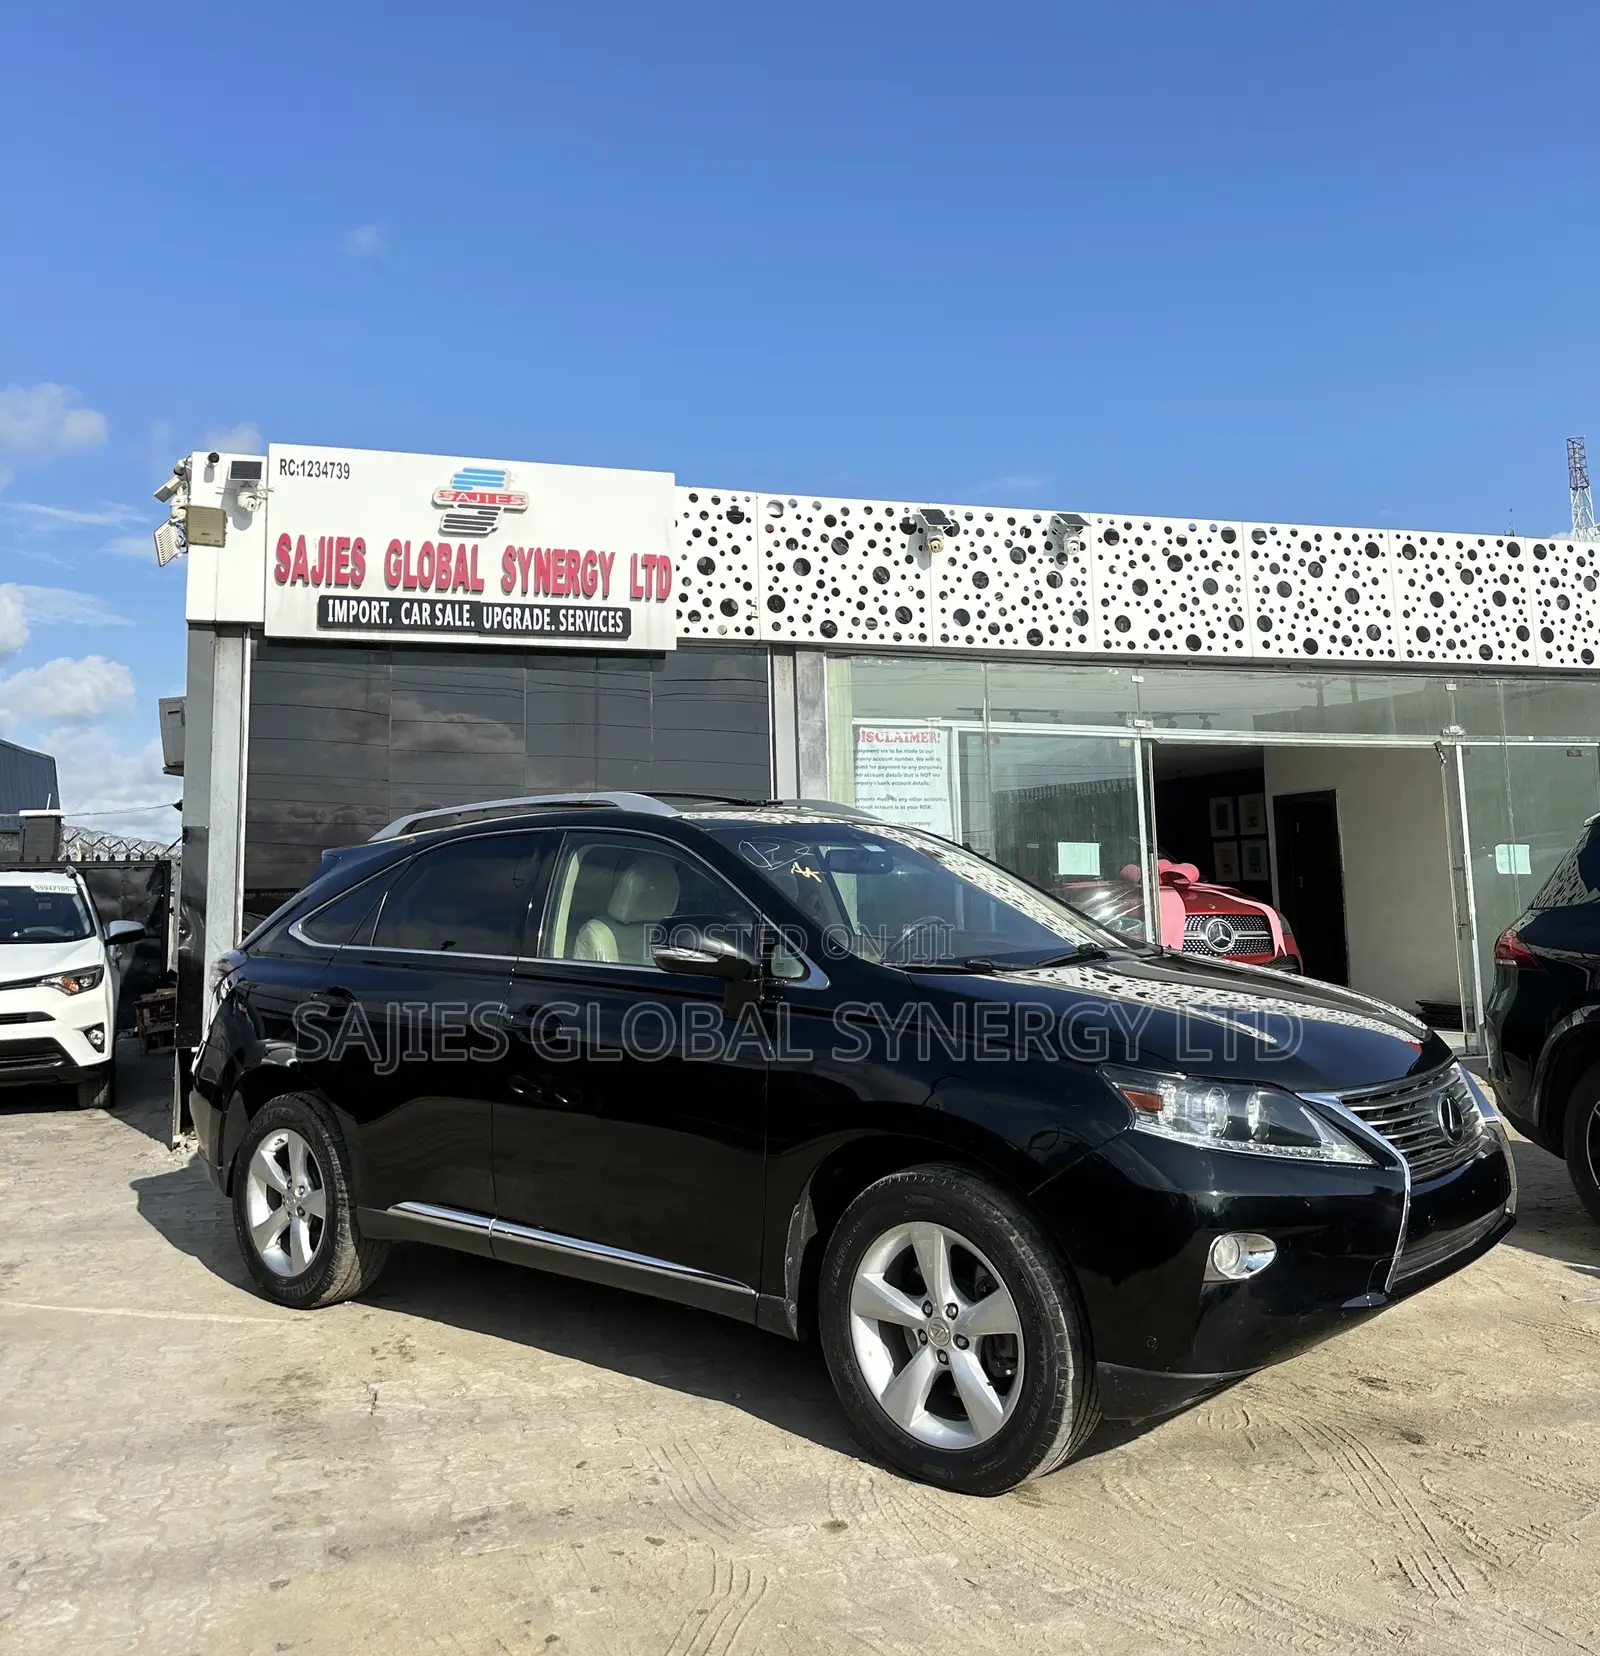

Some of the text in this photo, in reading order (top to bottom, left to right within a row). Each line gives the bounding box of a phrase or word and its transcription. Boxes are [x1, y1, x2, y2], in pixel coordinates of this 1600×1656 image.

[279, 458, 351, 480] RC:1234739
[438, 489, 527, 505] SAJIES
[274, 532, 673, 601] SAJIES GLOBAL SYNERGY LTD
[327, 599, 623, 633] IMPORT. CAR SALE. UPGRADE. SERVICES
